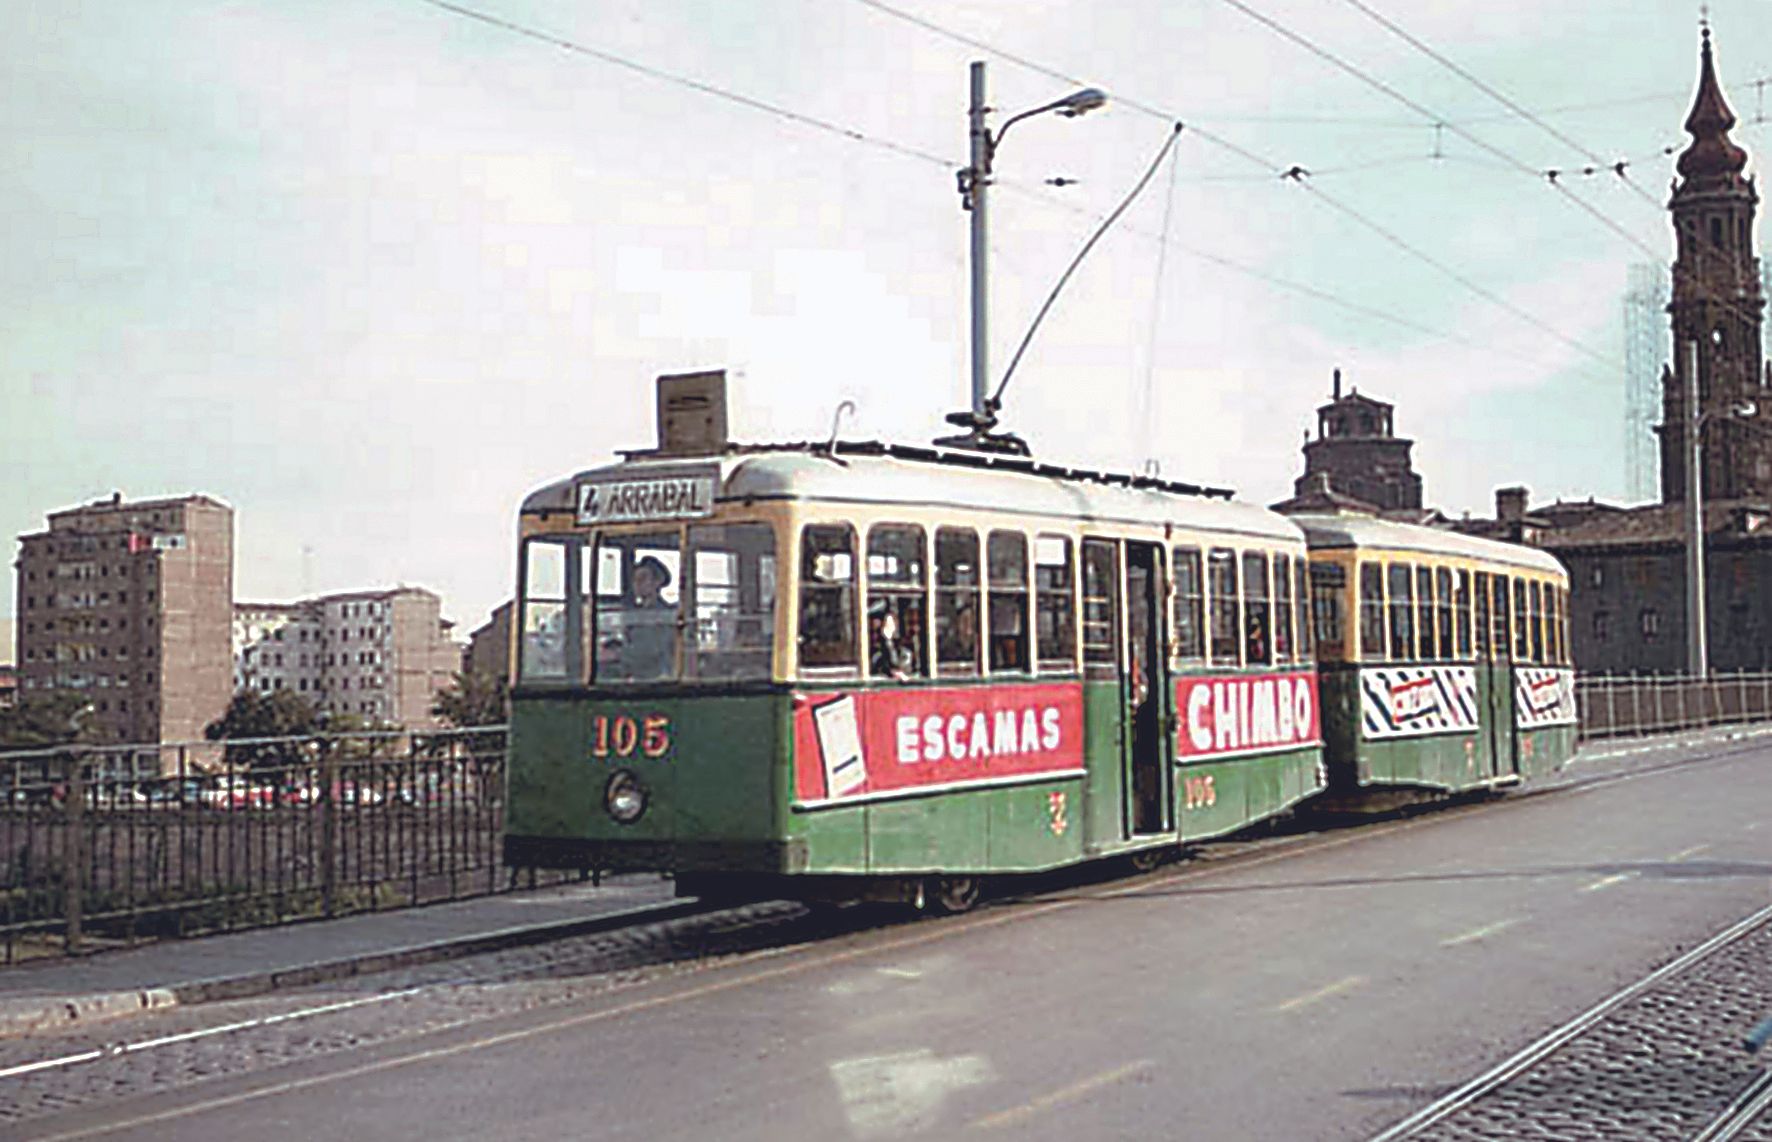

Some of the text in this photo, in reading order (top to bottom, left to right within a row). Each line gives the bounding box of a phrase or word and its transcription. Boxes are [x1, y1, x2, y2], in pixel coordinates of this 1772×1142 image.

[583, 481, 704, 517] 4 ARRABAL
[592, 714, 672, 758] 105
[896, 706, 1061, 764] ESCAMAS
[1187, 678, 1312, 751] CHIMBO
